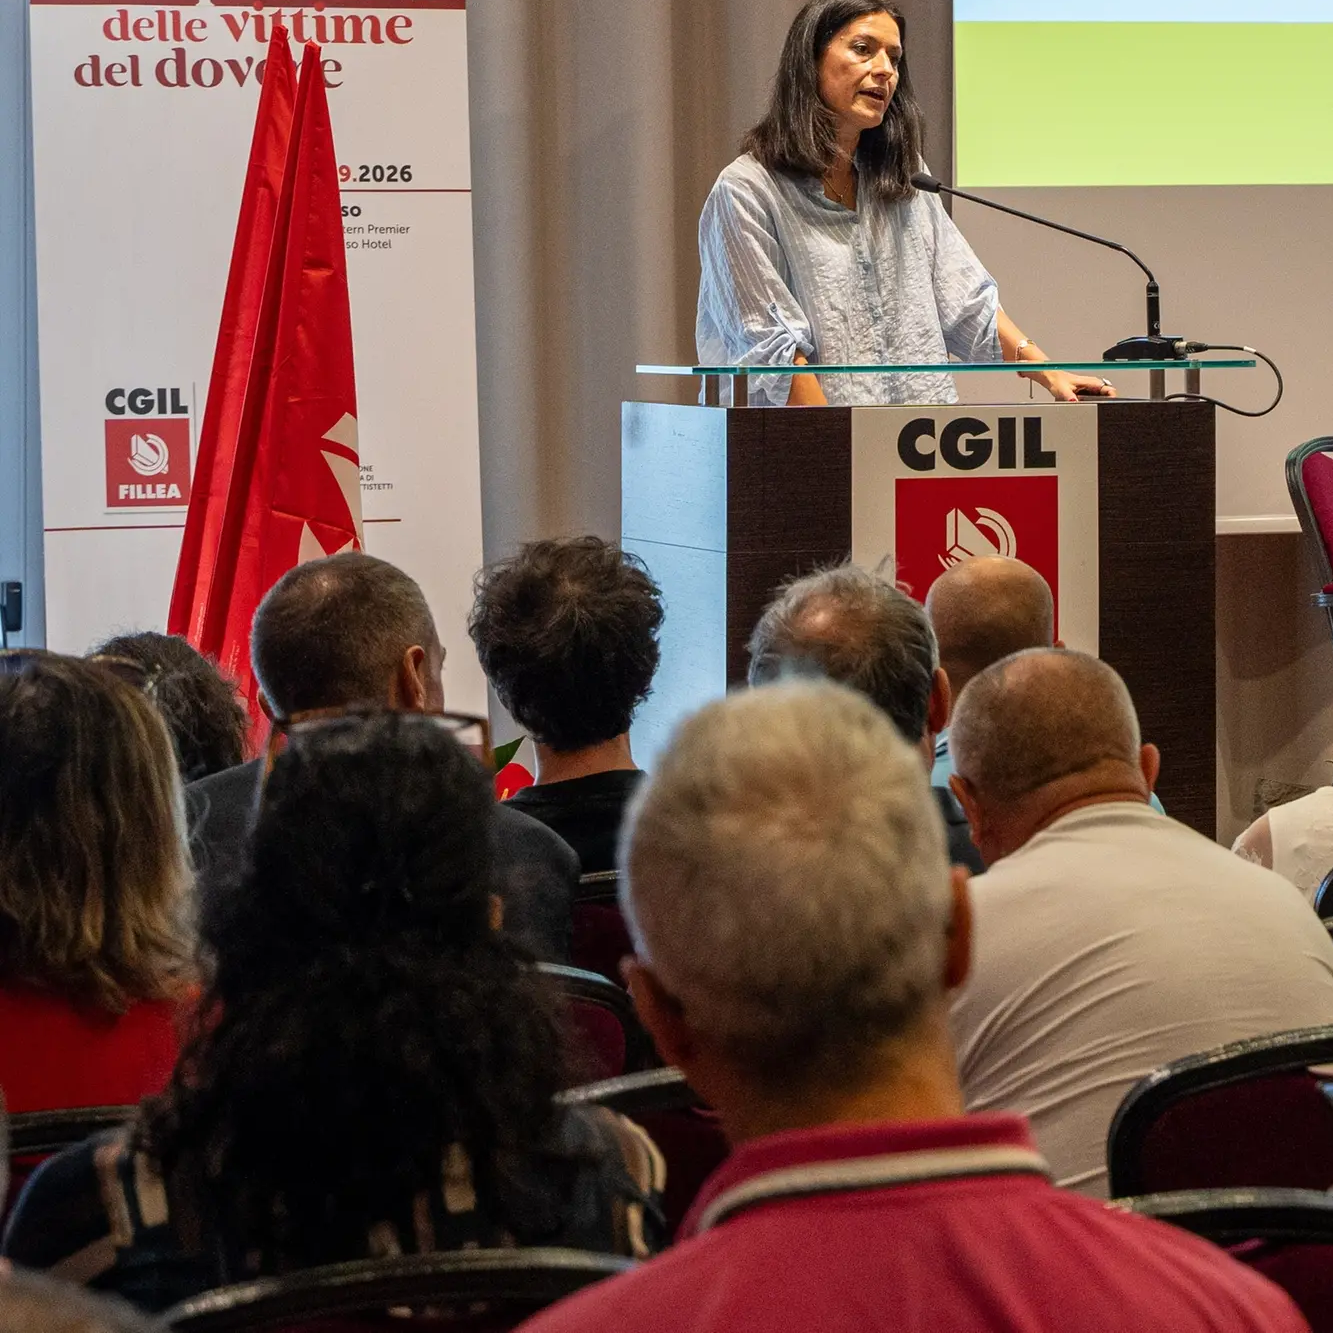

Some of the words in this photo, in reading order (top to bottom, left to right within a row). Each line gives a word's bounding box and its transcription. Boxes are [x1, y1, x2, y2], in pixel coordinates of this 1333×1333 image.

[102, 9, 208, 42] delle
[74, 55, 143, 88] del
[339, 165, 412, 182] 9.2026
[367, 224, 410, 234] Premier
[361, 239, 392, 249] Hotel
[105, 388, 188, 415] CGIL
[897, 417, 1056, 471] CGIL
[118, 483, 181, 499] FILLEA
